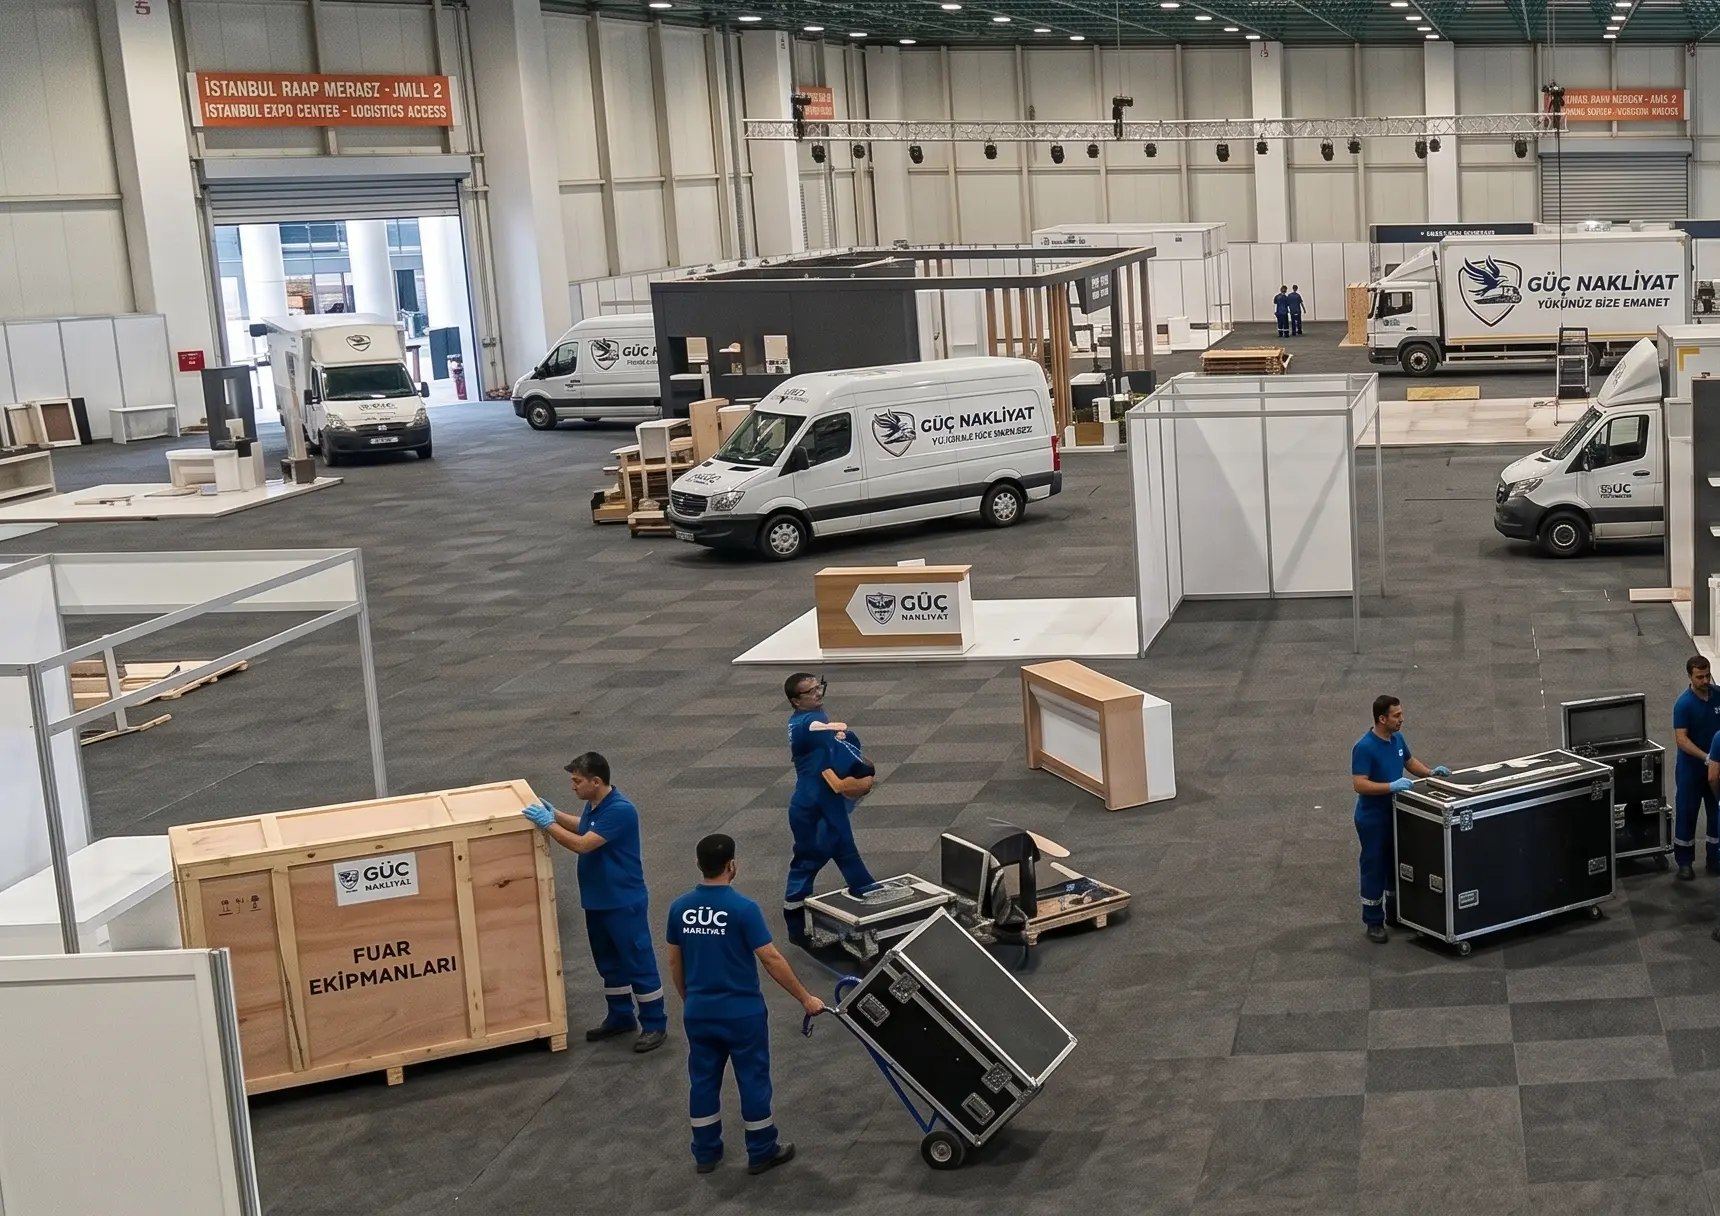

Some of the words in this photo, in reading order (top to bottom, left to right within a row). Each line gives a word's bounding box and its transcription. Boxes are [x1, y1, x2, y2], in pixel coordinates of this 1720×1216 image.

[205, 77, 277, 97] İSTANBUL
[282, 81, 319, 97] RAAP
[393, 83, 429, 98] JMLL
[434, 82, 442, 98] 2
[264, 103, 294, 118] EXPO
[351, 104, 404, 118] LOGISTICS
[408, 105, 447, 118] ACCESS
[1528, 271, 1571, 297] GÜÇ
[1576, 269, 1680, 291] NAKLİYAT
[1595, 297, 1621, 308] BİZE
[1623, 297, 1670, 308] EMANET
[960, 405, 1035, 428] NAKLİYAT
[900, 591, 948, 613] GÜÇ
[363, 861, 410, 882] GÜC
[682, 906, 728, 927] GÜC
[353, 940, 411, 964] FUAR
[309, 955, 457, 995] EKİPMANLARI
